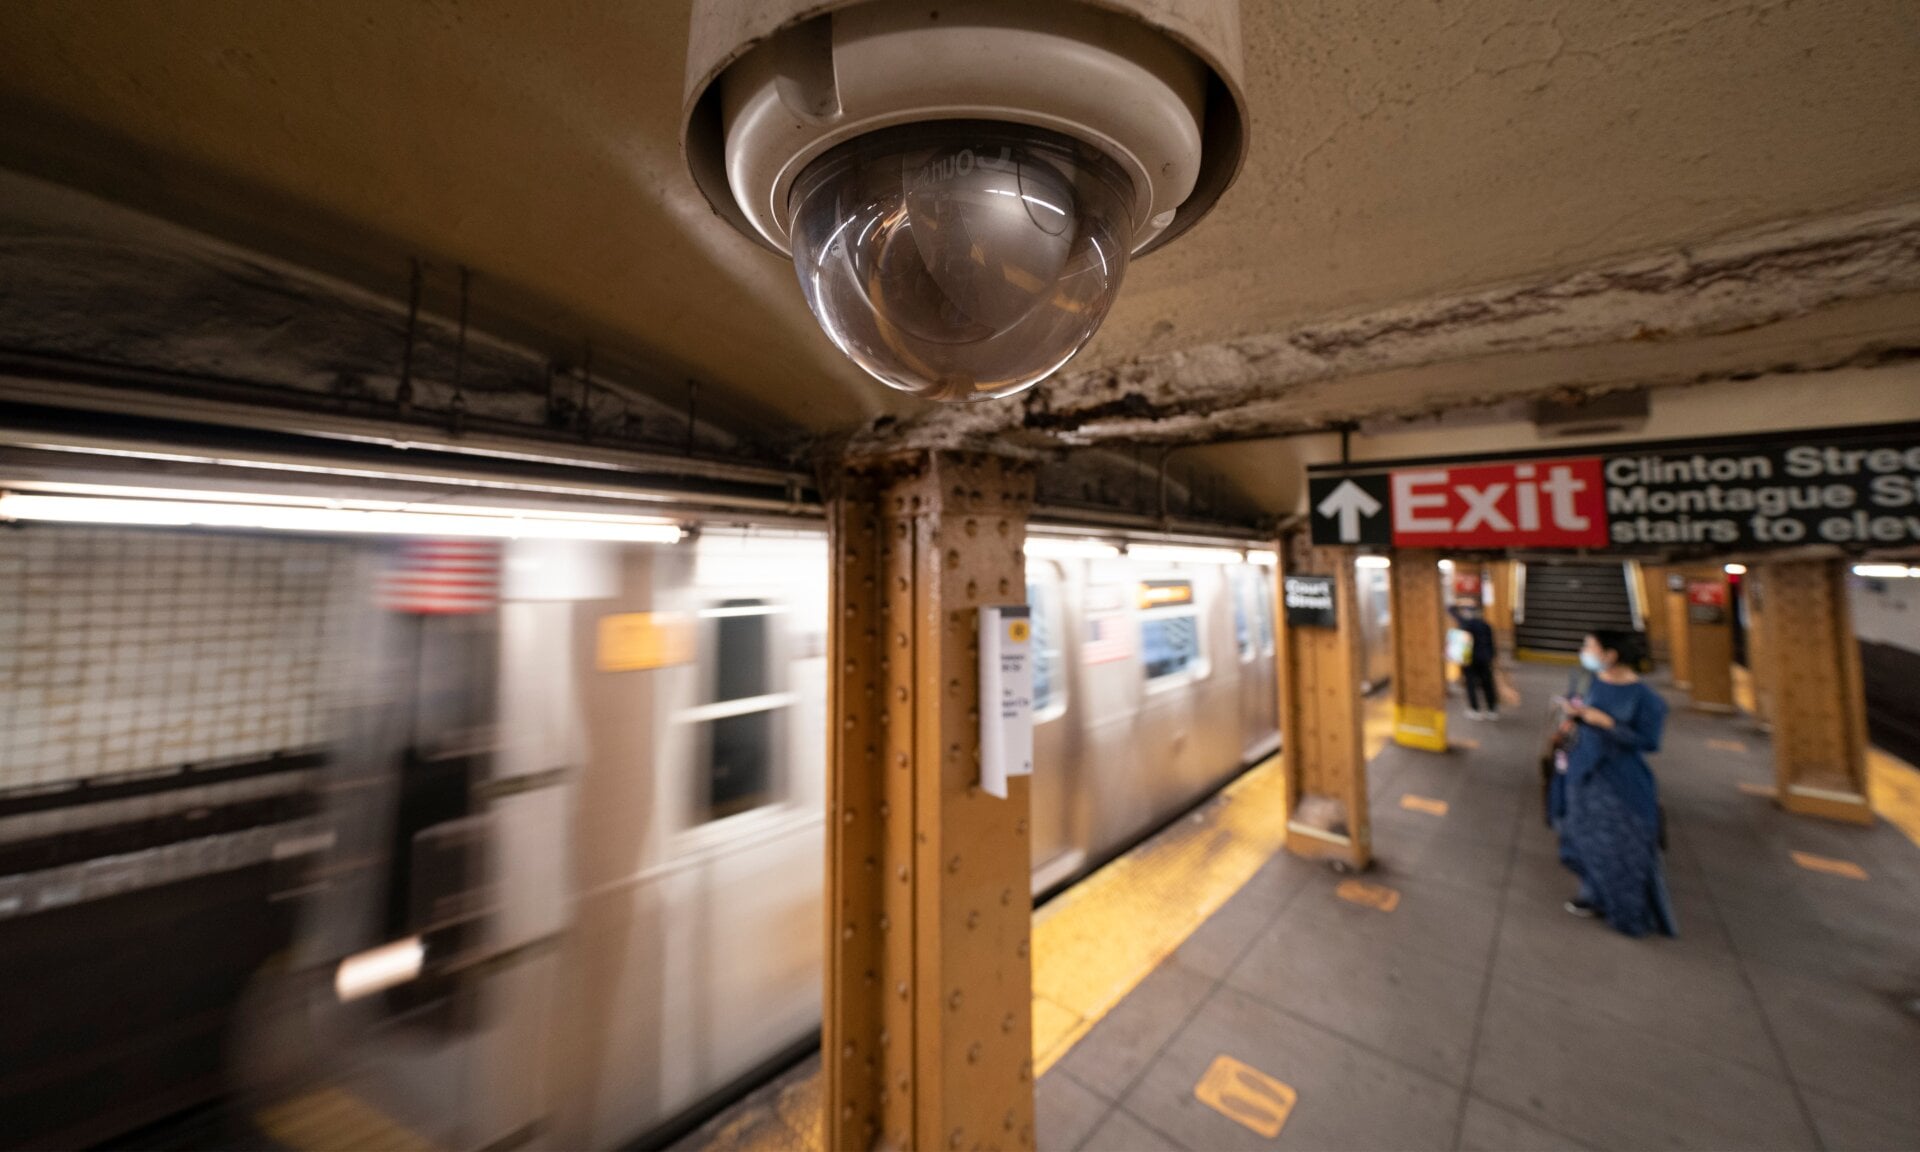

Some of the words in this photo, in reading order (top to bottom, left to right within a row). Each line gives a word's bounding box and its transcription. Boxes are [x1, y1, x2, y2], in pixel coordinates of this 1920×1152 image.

[1605, 455, 1773, 486] Clinton
[1391, 464, 1590, 533] Exit
[1606, 484, 1857, 516] Montague
[1610, 514, 1739, 543] stairs
[1751, 514, 1806, 542] to
